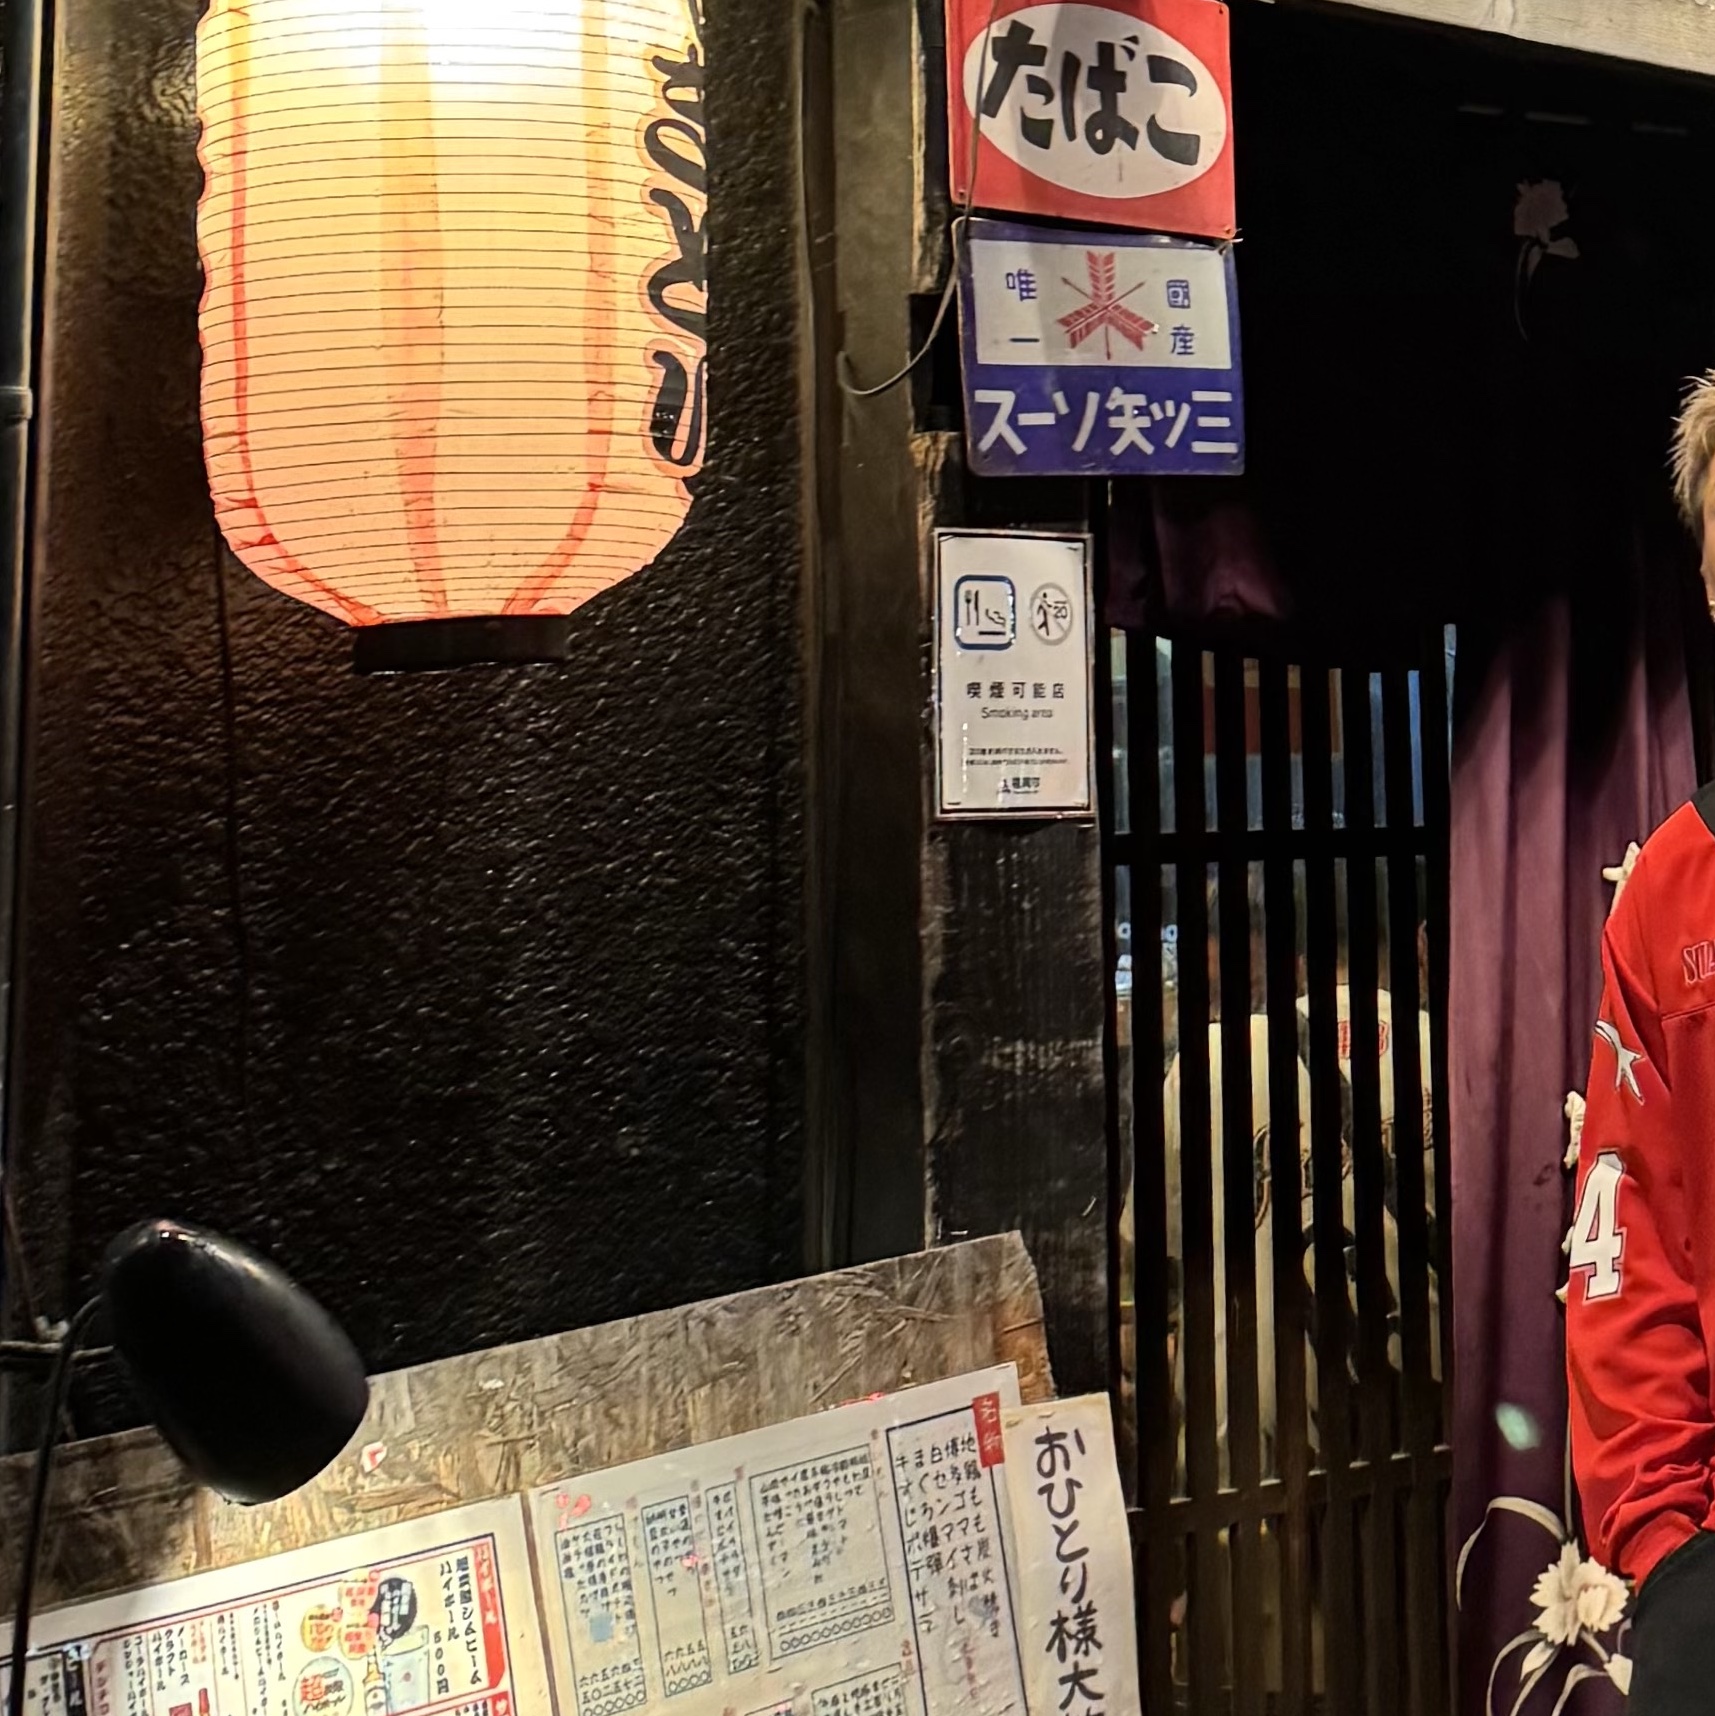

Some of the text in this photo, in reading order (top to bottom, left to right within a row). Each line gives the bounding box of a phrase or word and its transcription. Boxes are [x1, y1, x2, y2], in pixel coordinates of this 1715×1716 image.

[980, 19, 1201, 166] たばこ
[981, 706, 1054, 721] Smoking area
[930, 1446, 966, 1625] 白センマイ刺し
